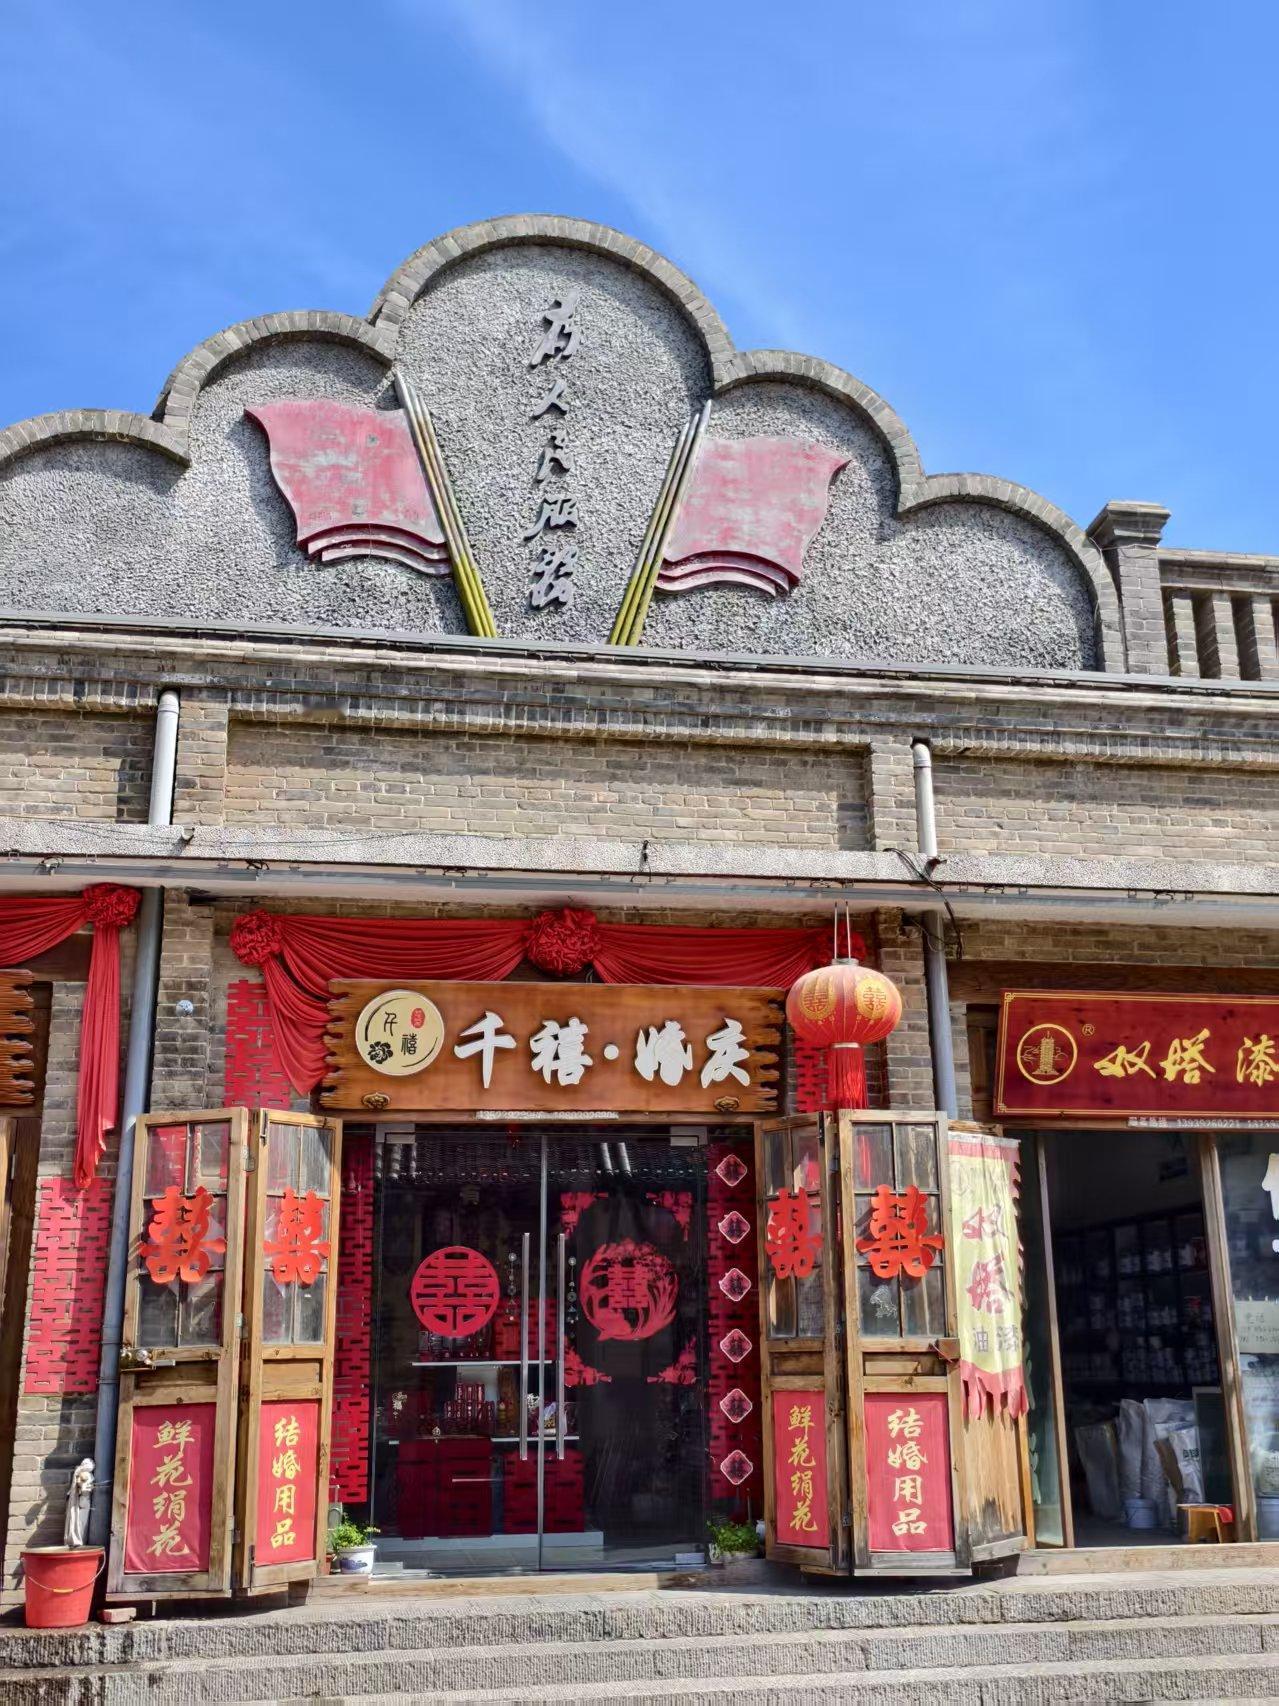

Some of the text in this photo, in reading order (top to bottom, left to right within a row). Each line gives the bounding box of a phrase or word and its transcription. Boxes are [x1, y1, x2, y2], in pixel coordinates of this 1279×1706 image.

[150, 1420, 196, 1557] 鲜花绢花
[270, 1416, 302, 1549] 结婚用品
[787, 1405, 818, 1532] 鲜花绢花
[886, 1409, 927, 1537] 结婚用品
